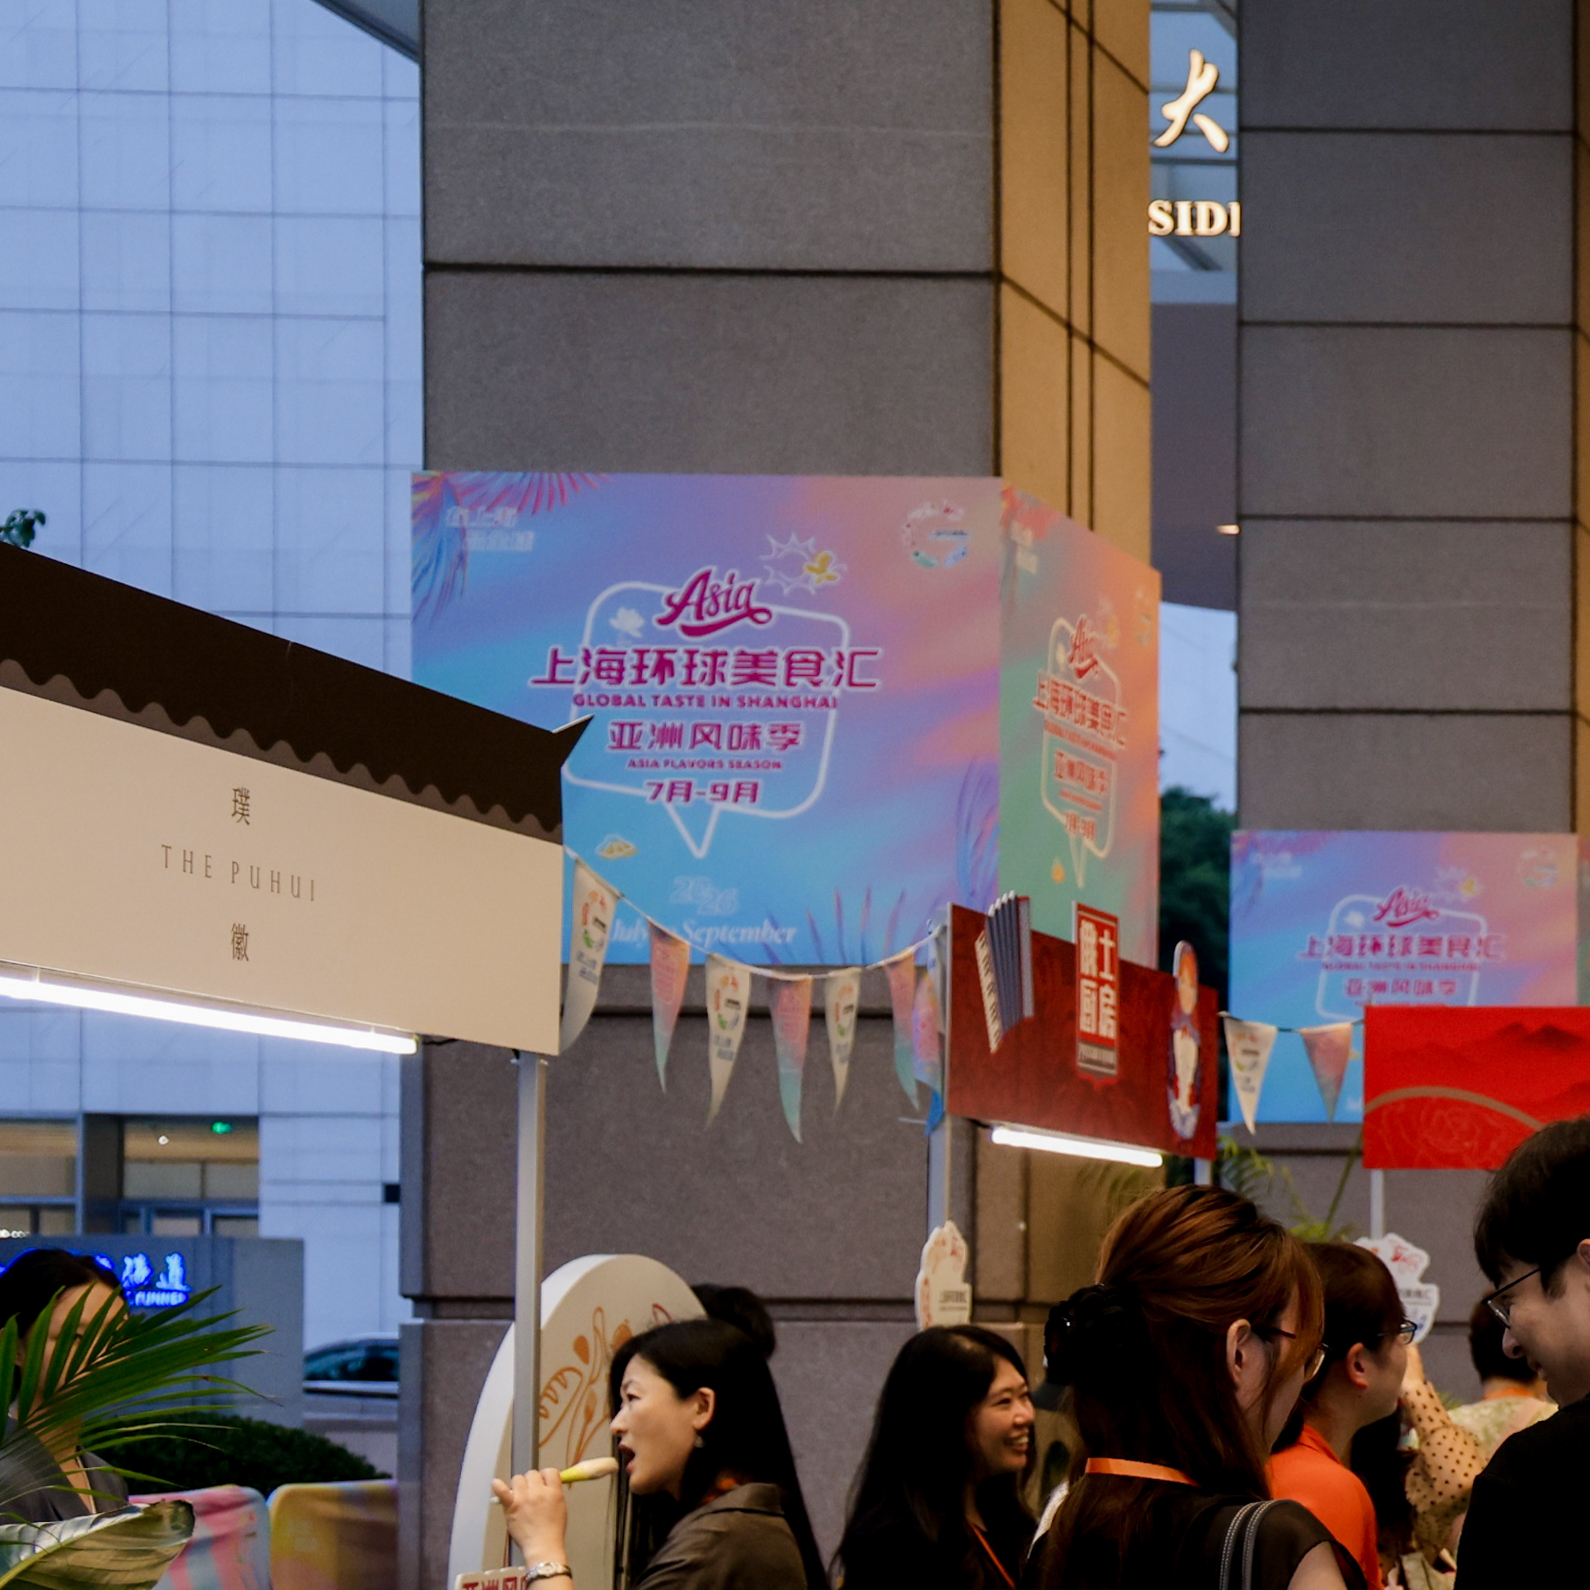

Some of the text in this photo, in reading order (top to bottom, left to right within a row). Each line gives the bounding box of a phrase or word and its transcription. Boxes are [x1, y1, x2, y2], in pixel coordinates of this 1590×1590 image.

[656, 567, 773, 638] Asia
[530, 647, 881, 689] 上海环球美食汇
[572, 694, 838, 709] GLOBAL TASTE IN SHANGHAI
[608, 721, 802, 751] 亚洲风味季
[627, 758, 782, 769] ASIA FLAVORS SEASON
[646, 780, 761, 803] 7月-9月
[161, 844, 315, 902] THE PUHUI
[684, 918, 797, 948] September
[1301, 934, 1503, 959] 上海环球美食汇
